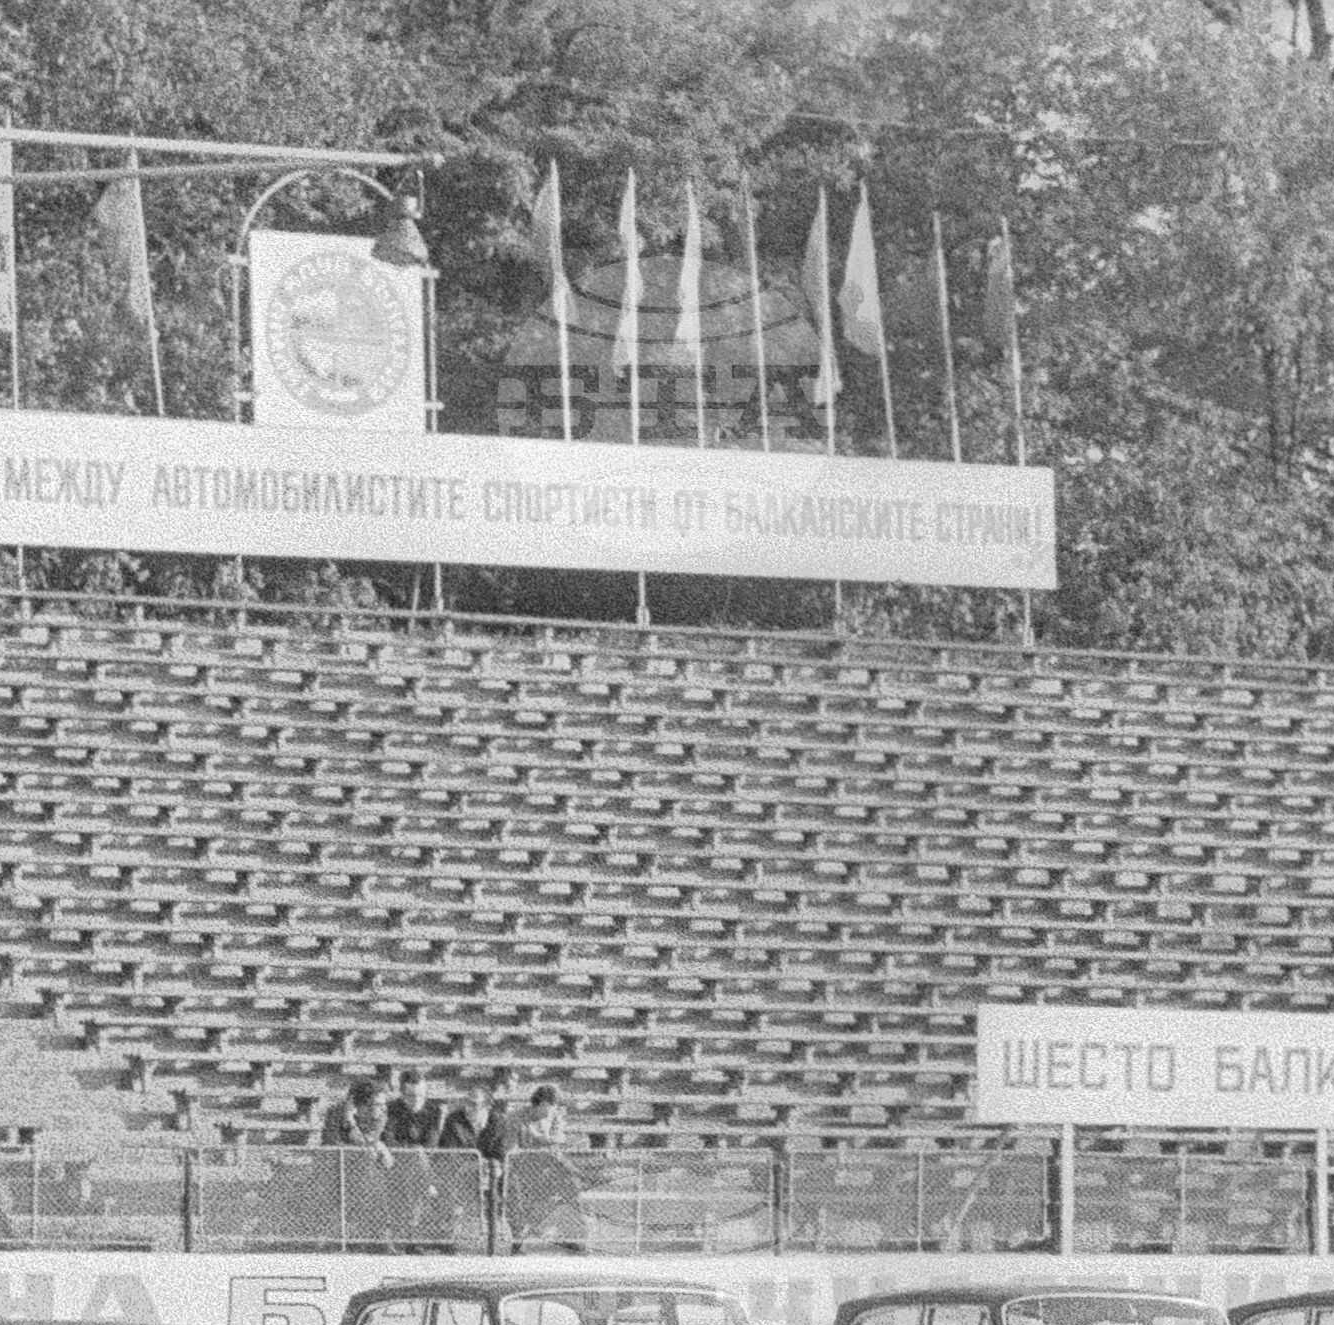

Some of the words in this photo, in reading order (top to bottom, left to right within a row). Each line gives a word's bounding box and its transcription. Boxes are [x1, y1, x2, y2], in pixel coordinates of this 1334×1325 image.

[3, 455, 126, 508] МЕЖДУ
[150, 462, 465, 522] АВТОМОБИЛИСТИТЕ
[726, 490, 925, 541] БАЛКАНСКИТЕ
[1001, 1038, 1176, 1092] ШЕСТО
